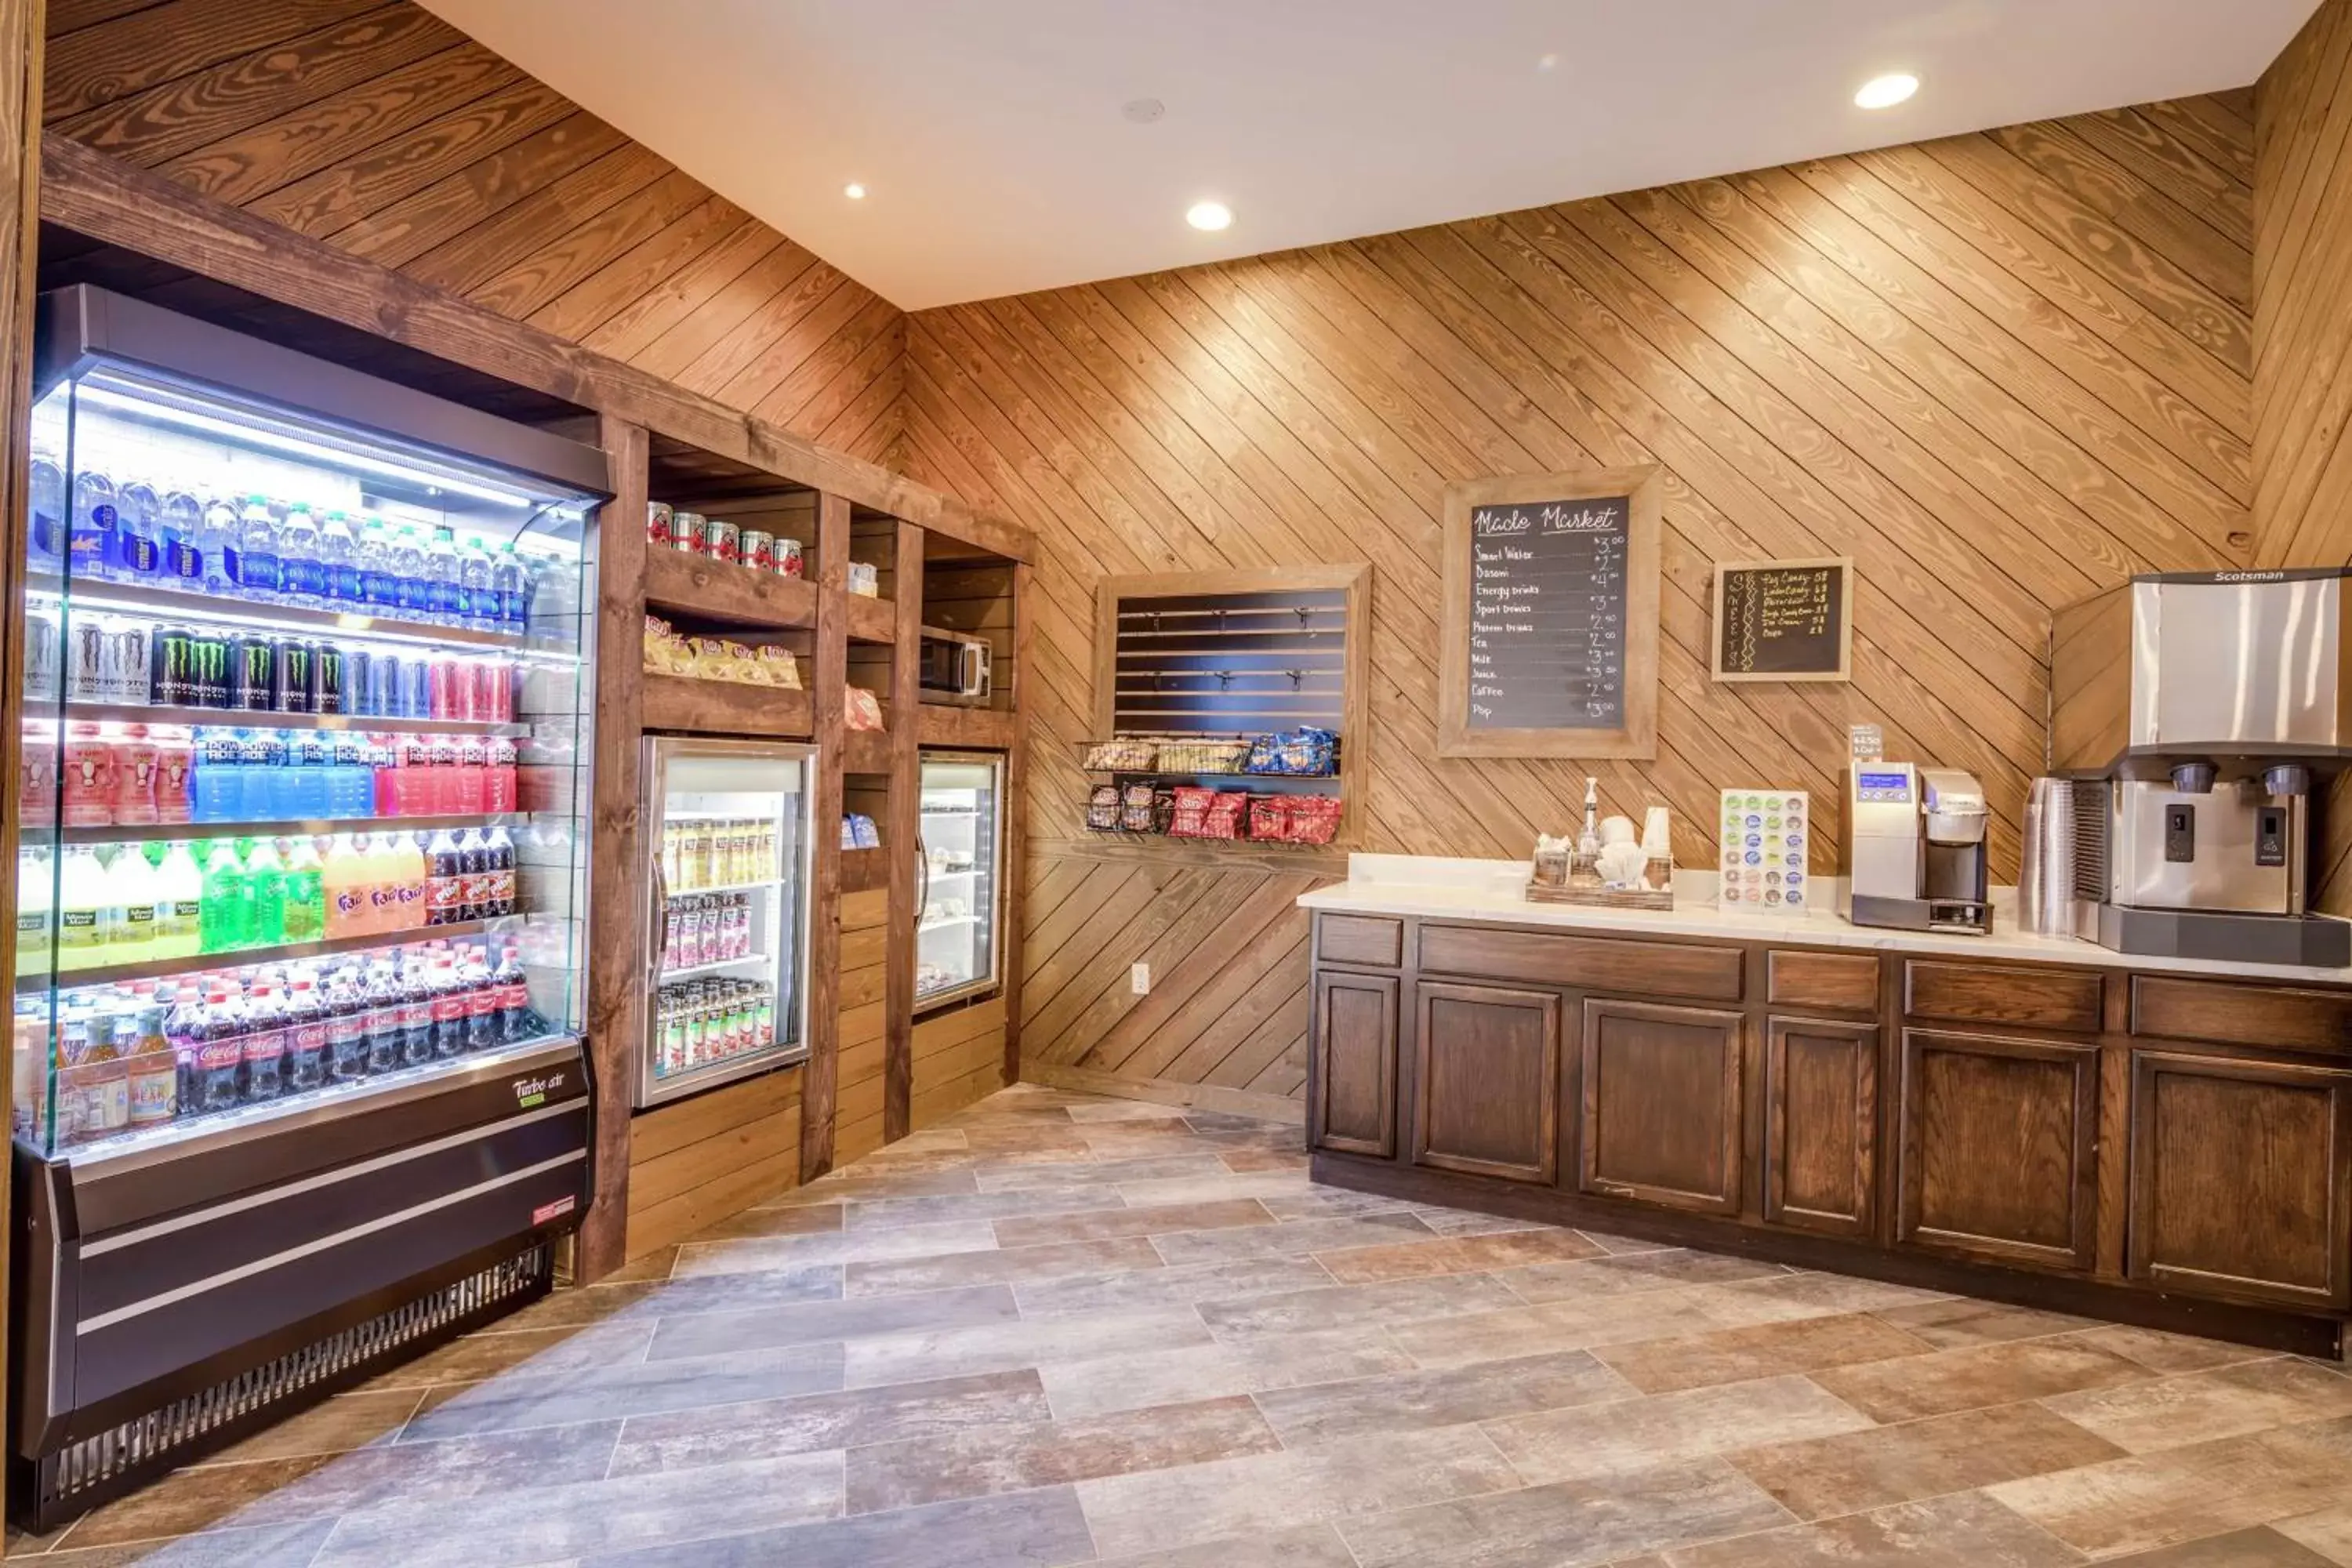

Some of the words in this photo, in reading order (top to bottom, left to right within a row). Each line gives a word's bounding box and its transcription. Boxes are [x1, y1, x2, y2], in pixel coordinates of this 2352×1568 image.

[1475, 510, 1531, 532] Made
[1541, 506, 1618, 531] Market
[2214, 571, 2285, 581] Scotsman
